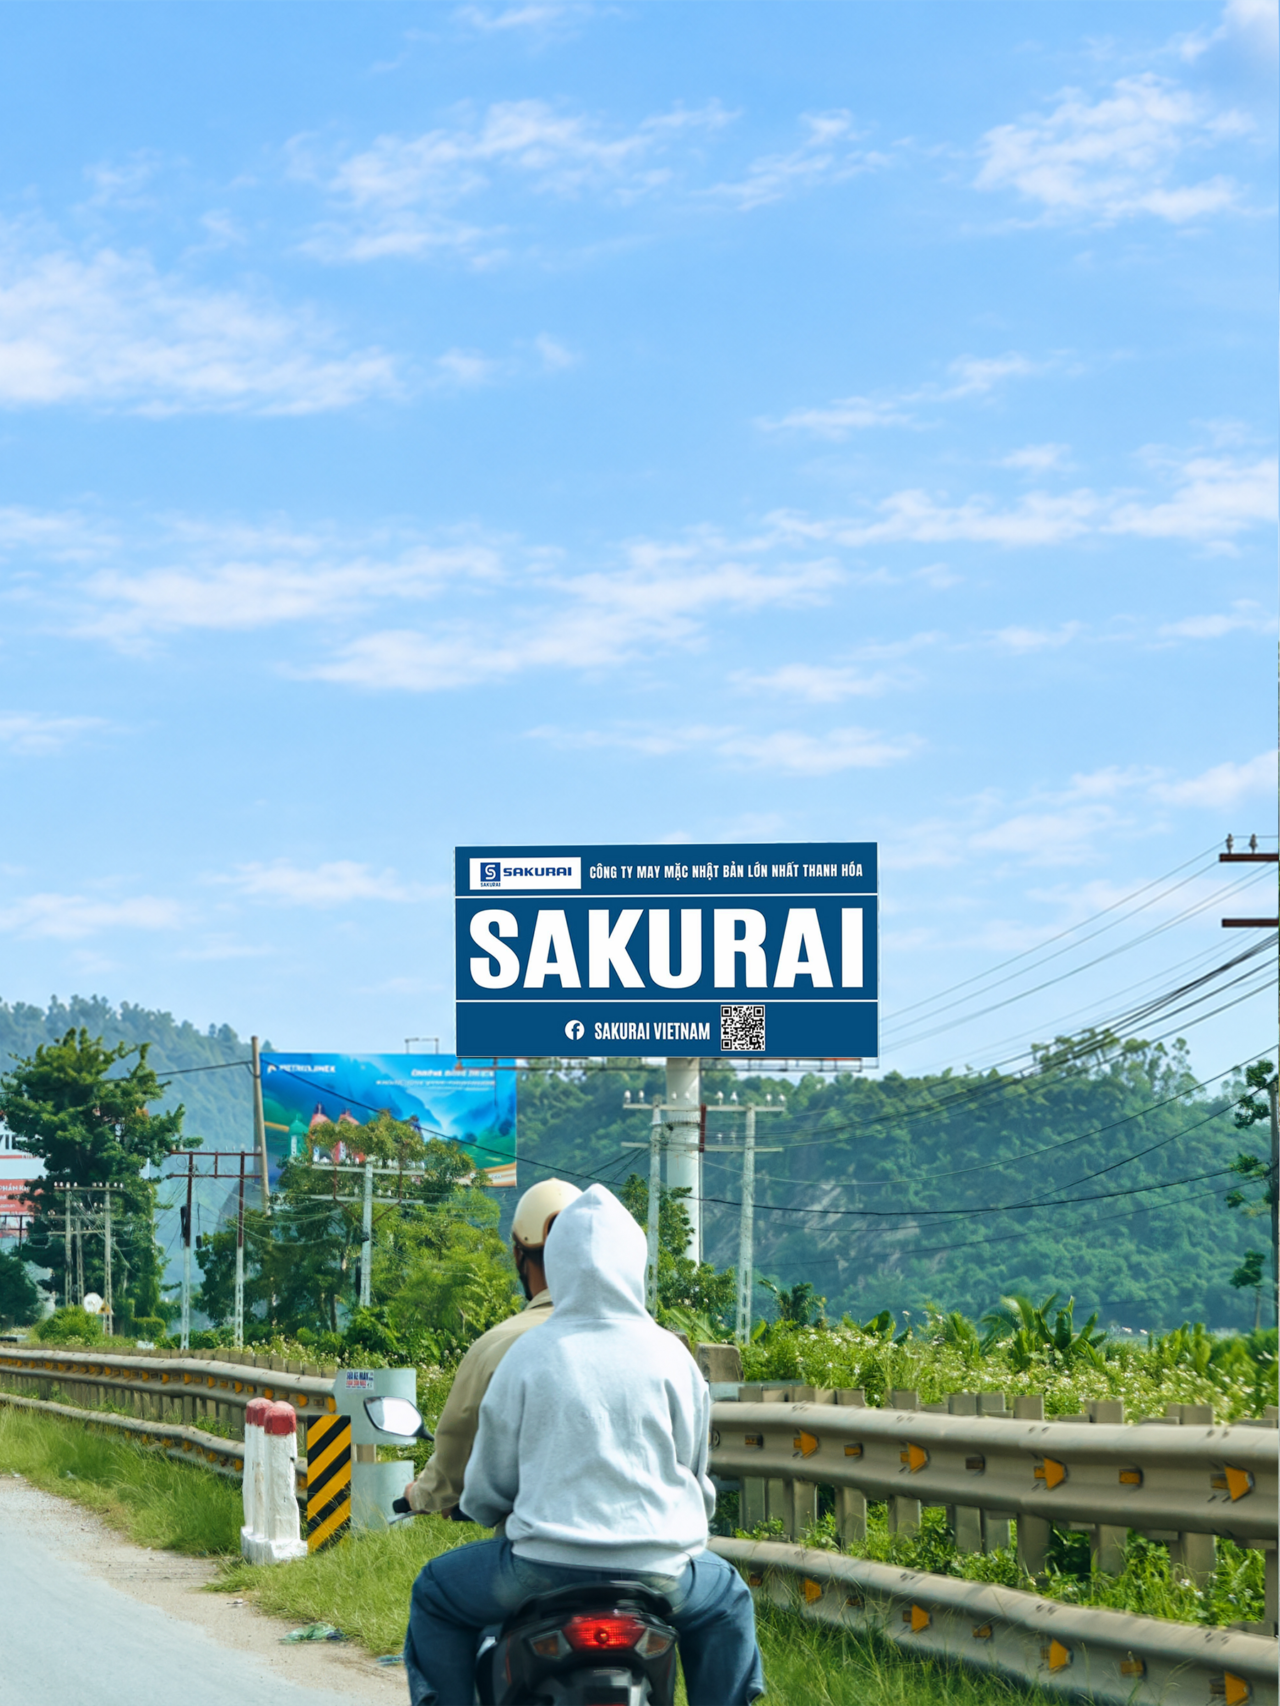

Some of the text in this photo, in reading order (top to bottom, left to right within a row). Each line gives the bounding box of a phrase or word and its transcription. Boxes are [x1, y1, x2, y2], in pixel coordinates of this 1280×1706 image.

[503, 866, 572, 877] SAKURAI
[589, 861, 863, 881] CÔNG TY MAY MẶC NHẬT BẢN LỚN NHẤT THANH HÓA
[469, 908, 864, 989] SAKURAI
[594, 1022, 711, 1040] SAKURAI VIETNAM
